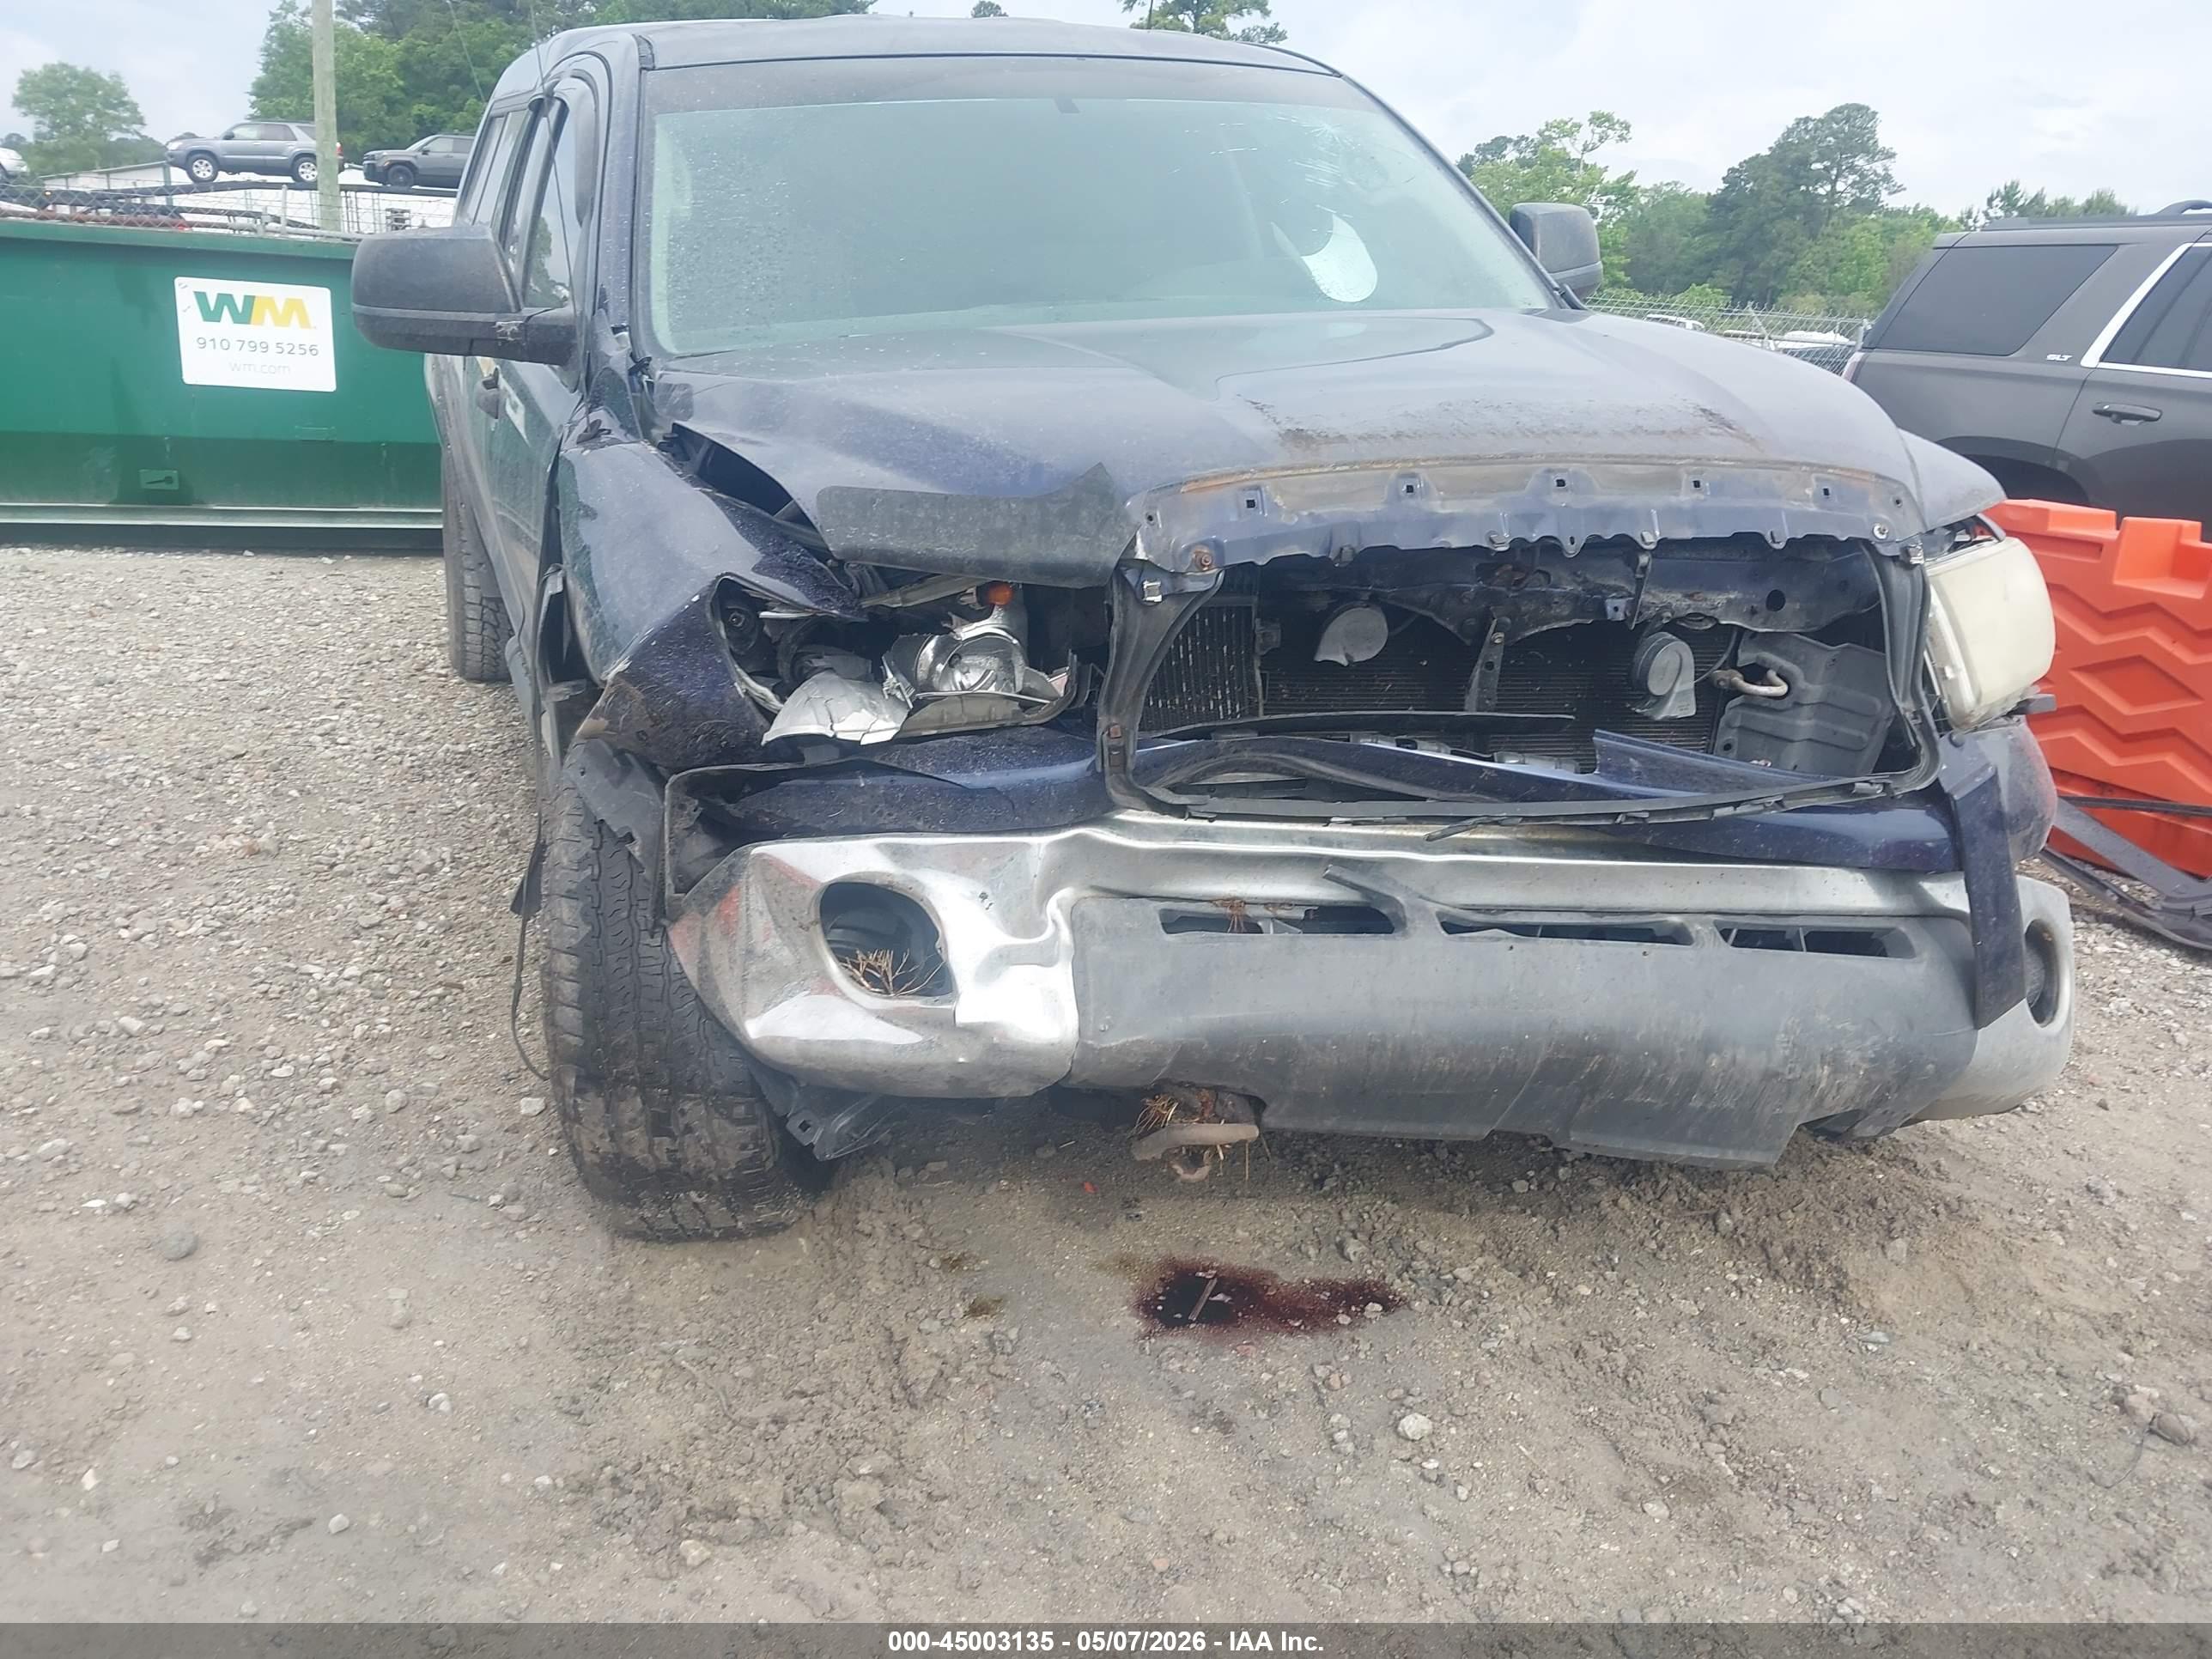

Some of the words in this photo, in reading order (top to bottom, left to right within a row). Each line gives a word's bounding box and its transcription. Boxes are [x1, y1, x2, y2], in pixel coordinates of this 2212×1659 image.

[193, 291, 312, 329] WM
[197, 337, 230, 350] 910
[236, 339, 269, 353] 799
[276, 342, 319, 356] 5256
[229, 361, 291, 375] wm.com
